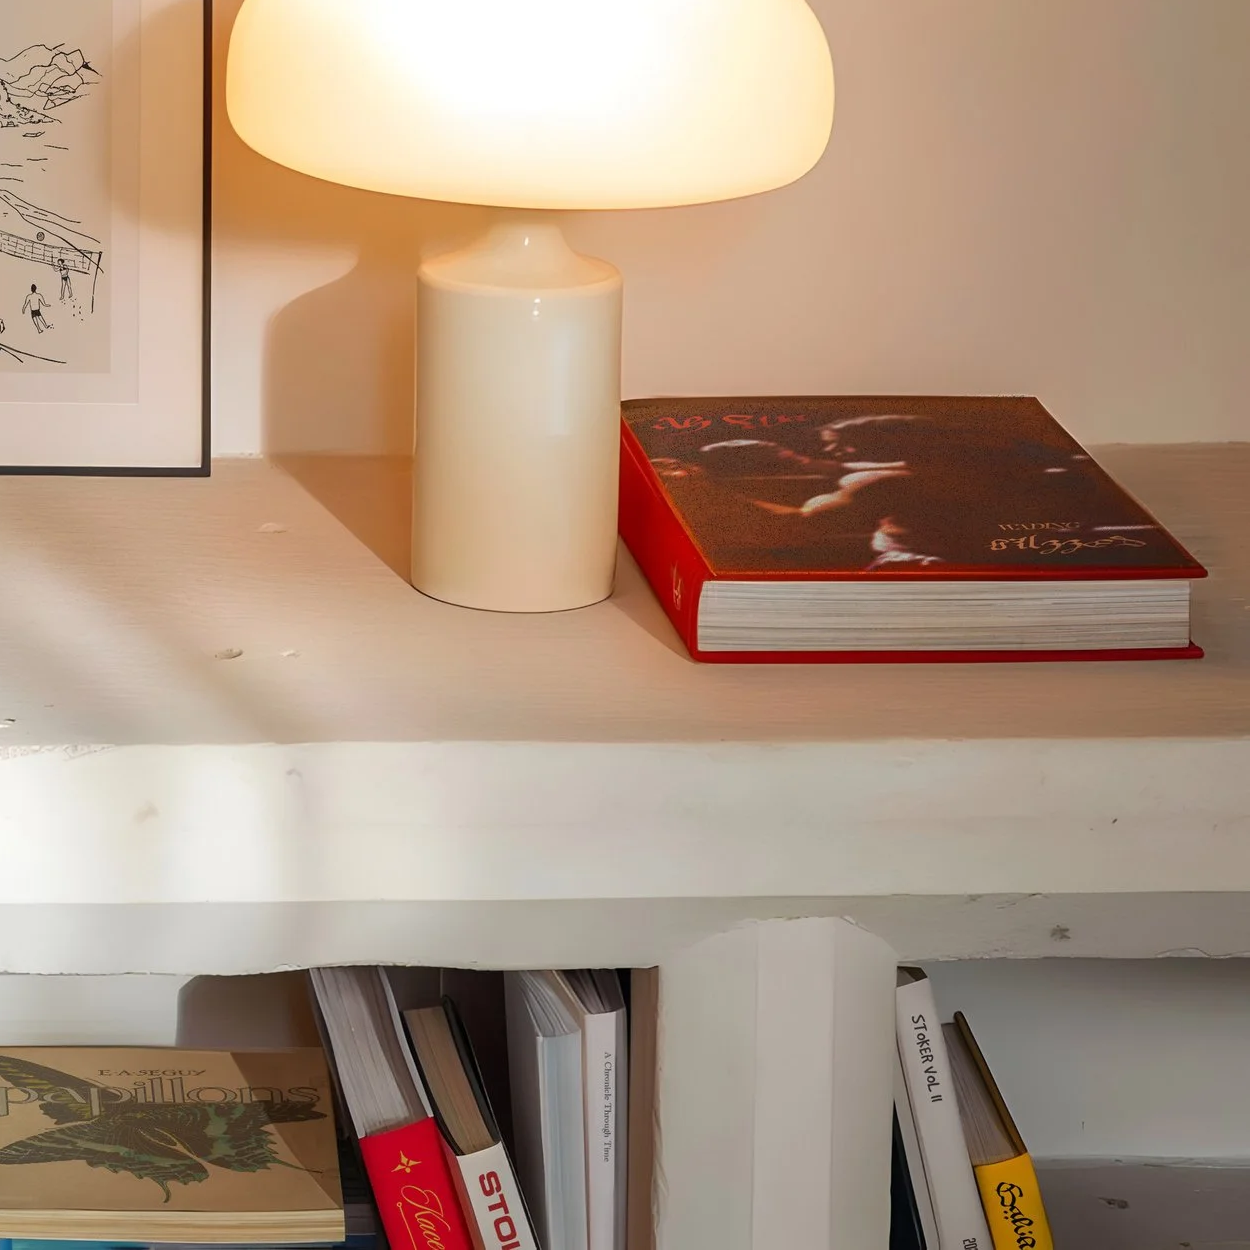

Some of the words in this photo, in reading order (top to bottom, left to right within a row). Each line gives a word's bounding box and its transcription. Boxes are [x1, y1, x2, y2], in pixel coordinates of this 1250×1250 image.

[604, 1051, 612, 1060] A
[603, 1061, 613, 1101] Chronicle
[601, 1102, 613, 1138] Through
[602, 1140, 612, 1163] Time
[962, 1237, 978, 1250] 20
